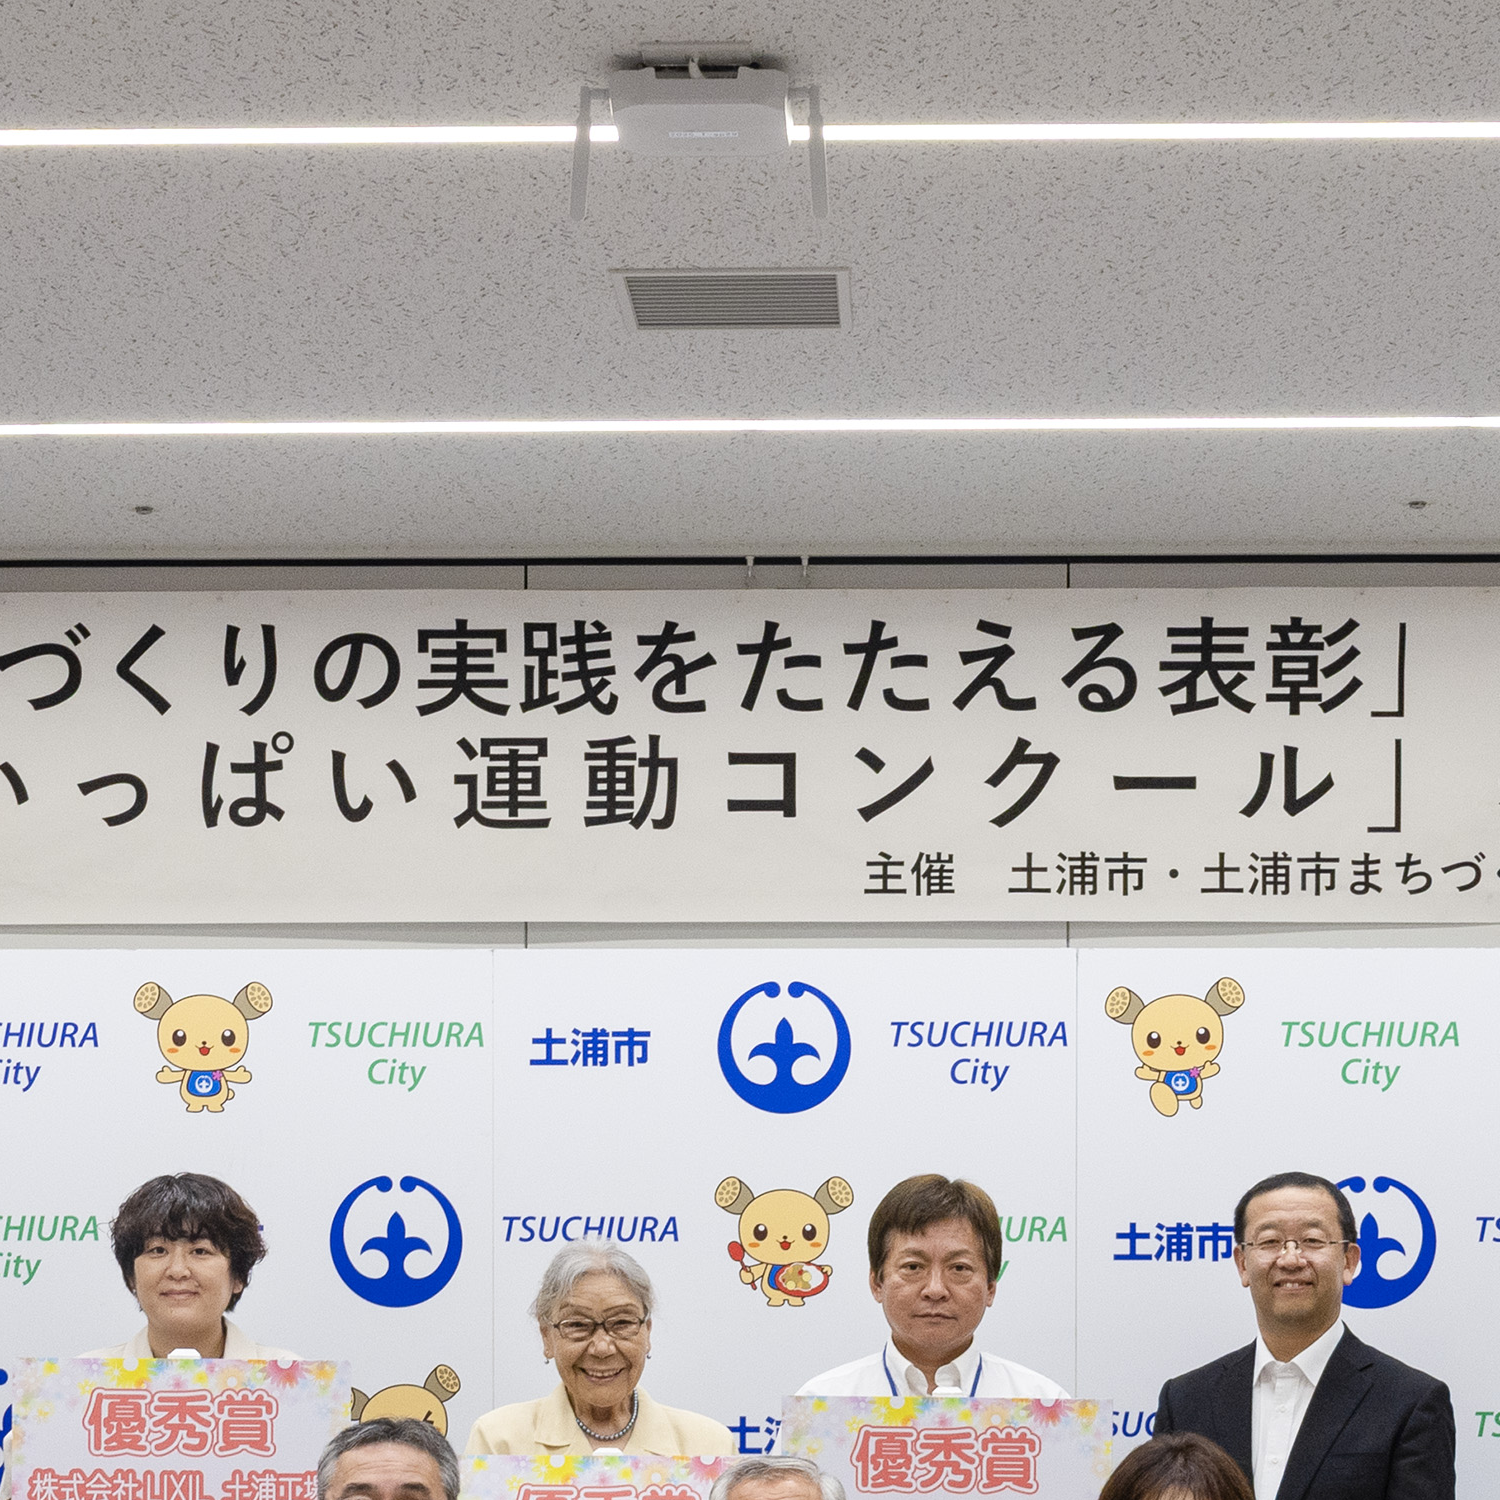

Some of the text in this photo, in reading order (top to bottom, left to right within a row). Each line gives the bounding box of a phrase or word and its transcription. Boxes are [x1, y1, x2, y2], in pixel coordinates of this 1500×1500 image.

[864, 852, 954, 896] 主催
[310, 1023, 482, 1047] TSUCHIURA
[530, 1028, 651, 1067] 土浦市
[891, 1021, 1067, 1047] TSUCHIURA
[1283, 1022, 1458, 1047] TSUCHIURA
[369, 1060, 425, 1090] City
[951, 1058, 1009, 1091] City
[1342, 1059, 1399, 1091] City
[502, 1215, 680, 1243] TSUCHIURA
[1113, 1222, 1235, 1262] 土浦市
[83, 1388, 278, 1458] 優秀賞
[851, 1425, 1042, 1494] 優秀賞
